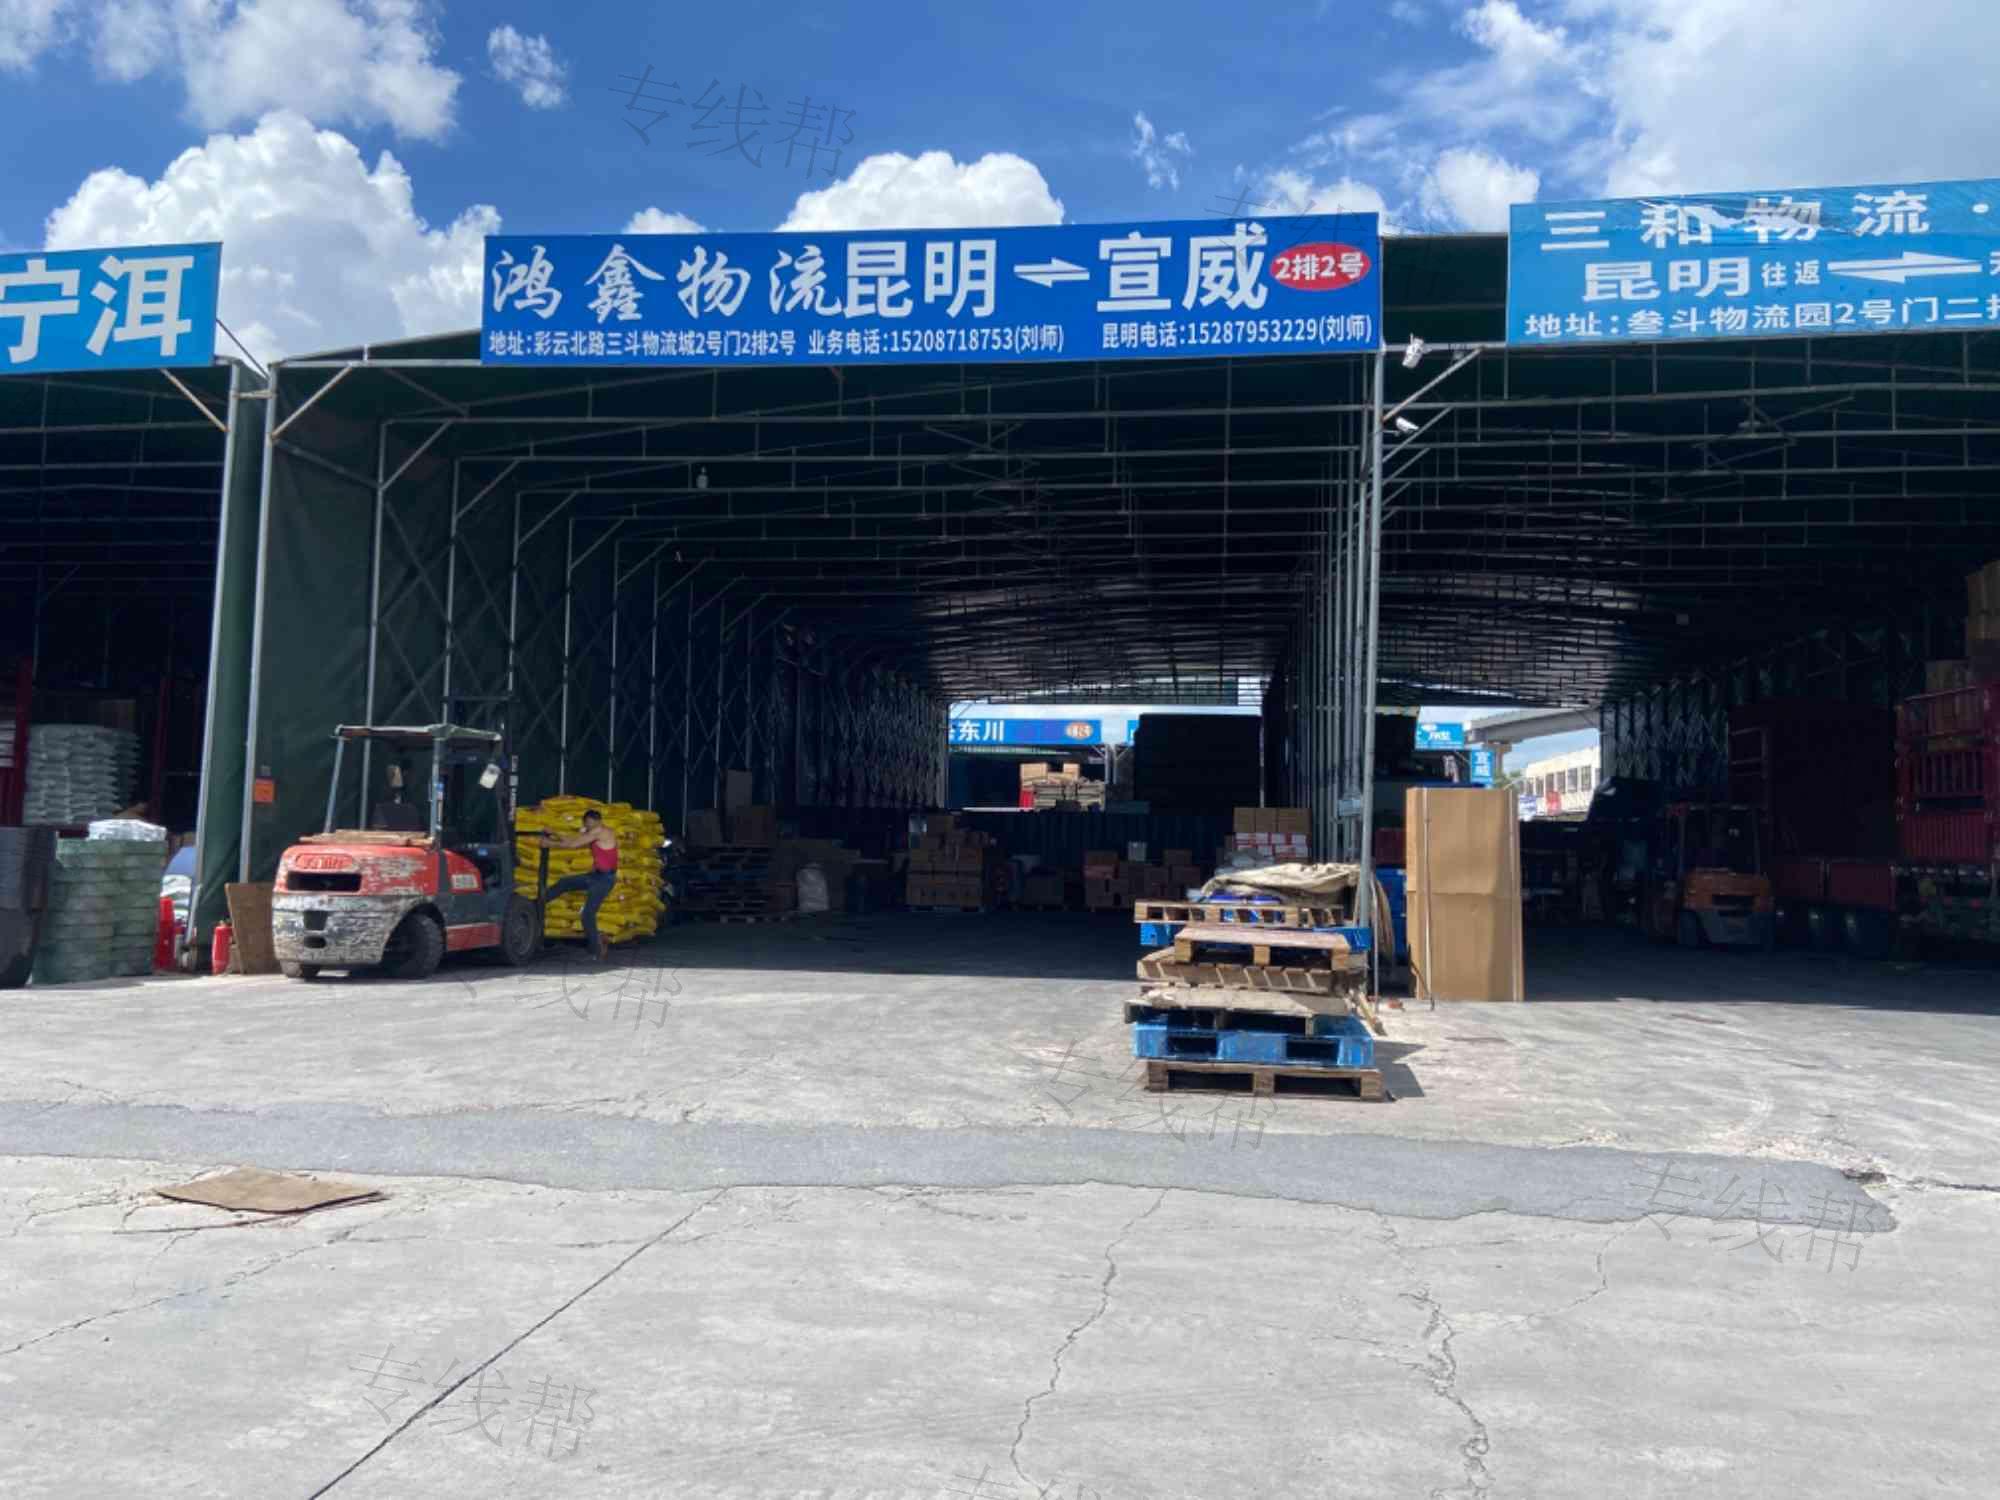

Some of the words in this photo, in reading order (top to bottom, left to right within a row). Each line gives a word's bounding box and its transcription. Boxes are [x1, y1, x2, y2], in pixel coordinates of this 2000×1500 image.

[1275, 251, 1364, 281] 2排2号
[1582, 256, 1750, 302] 昆明
[1761, 259, 1821, 287] 往返
[0, 255, 195, 363] 宁洱
